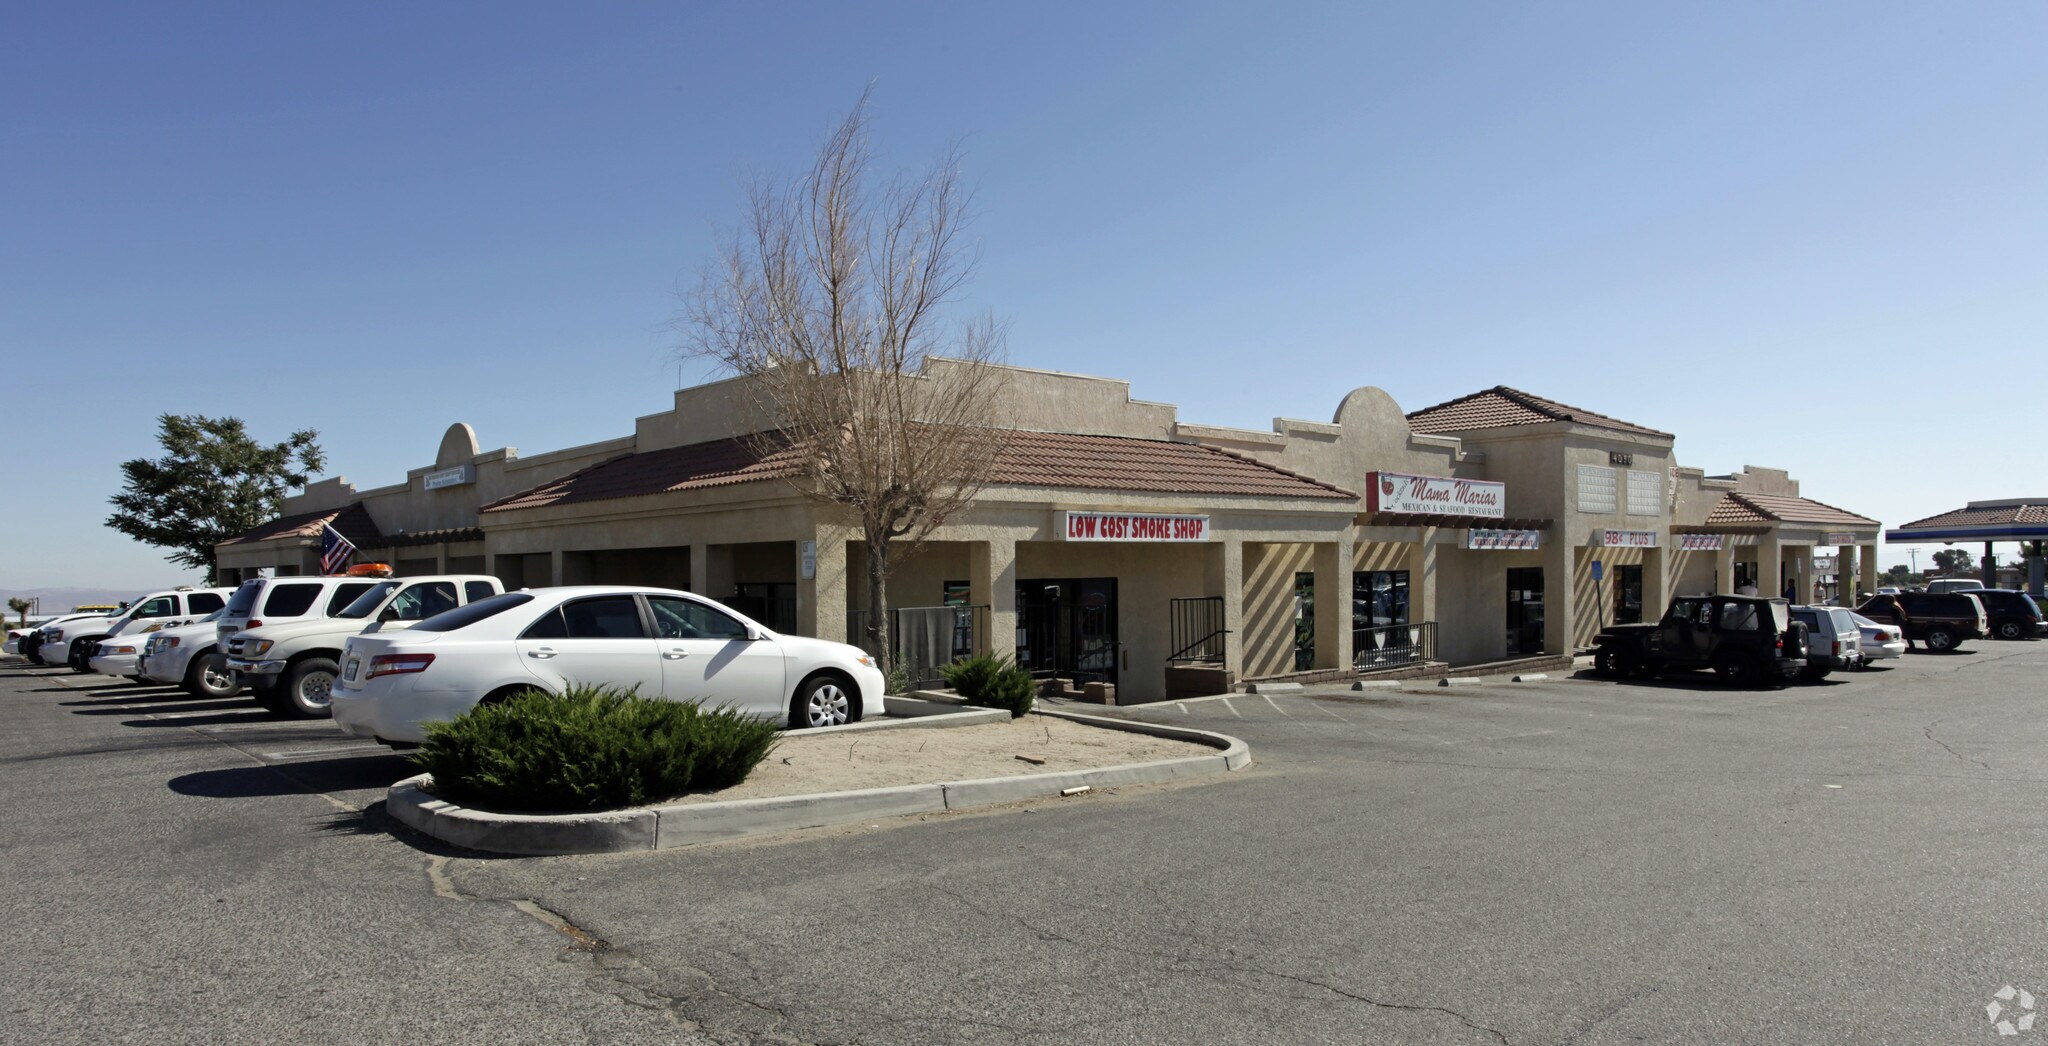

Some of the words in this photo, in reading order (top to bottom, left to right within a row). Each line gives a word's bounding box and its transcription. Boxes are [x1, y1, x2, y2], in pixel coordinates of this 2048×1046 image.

[1410, 477, 1450, 502] Mama
[1454, 481, 1498, 506] Marias
[1402, 503, 1431, 512] MEXICAN
[1440, 505, 1465, 514] SEAFOOD
[1468, 506, 1502, 516] RESTAURANT
[1068, 516, 1097, 538] LOW
[1100, 516, 1129, 539] COST
[1132, 516, 1171, 539] SMOKE
[1174, 518, 1203, 539] SHOP
[1629, 532, 1648, 545] PLUS
